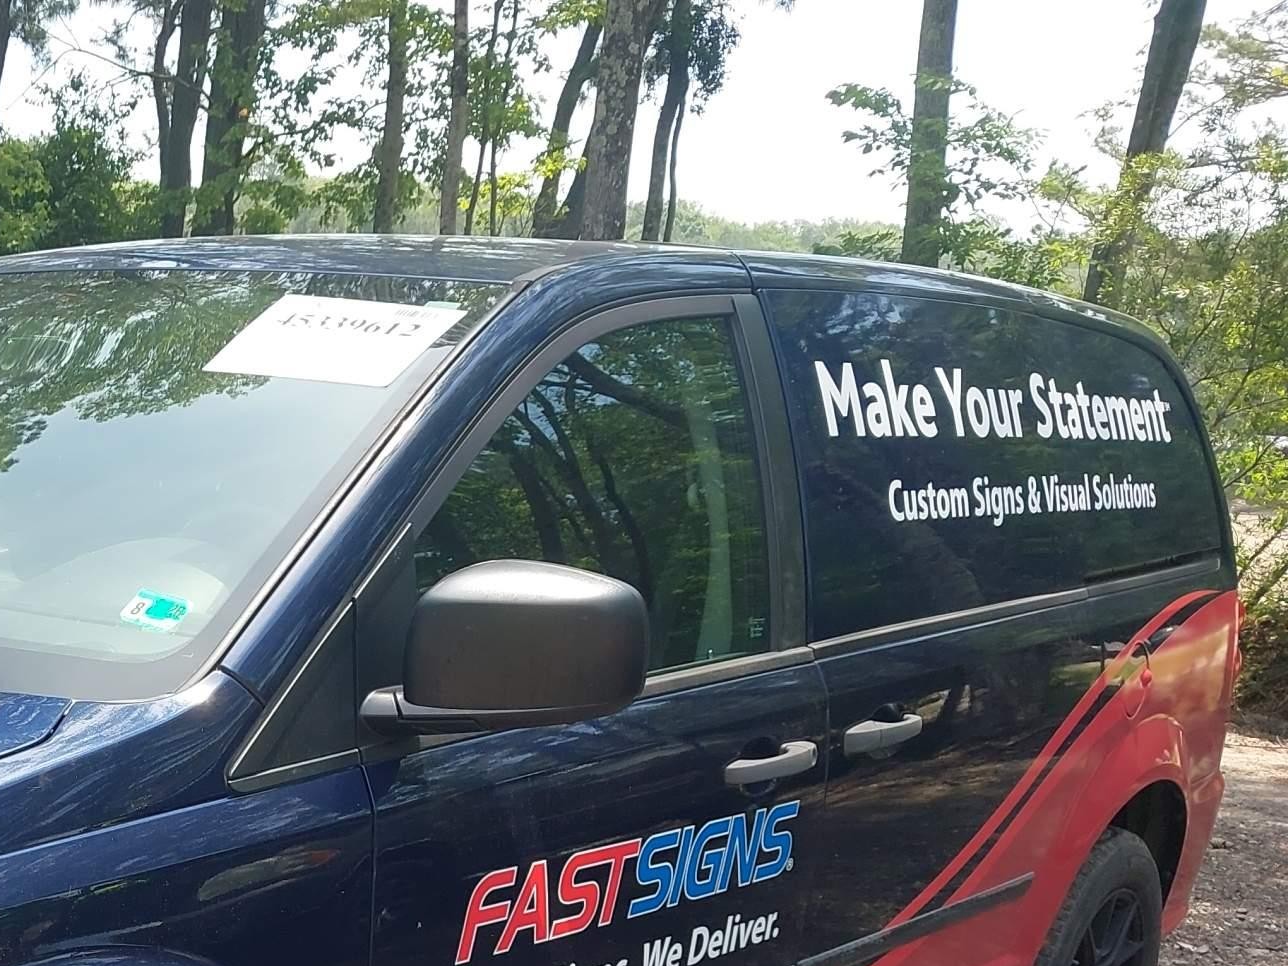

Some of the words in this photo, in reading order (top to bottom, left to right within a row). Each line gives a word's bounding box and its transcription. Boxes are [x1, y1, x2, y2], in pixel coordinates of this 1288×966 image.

[814, 358, 939, 438] Make
[934, 366, 1023, 438] Your
[1028, 371, 1172, 443] Statement
[888, 479, 970, 522] Custom
[972, 475, 1025, 527] Signs
[1027, 475, 1042, 513] &
[1041, 474, 1092, 512] Visual
[1092, 473, 1156, 511] Solutions
[130, 601, 145, 615] 8
[687, 911, 780, 965] Deliver.
